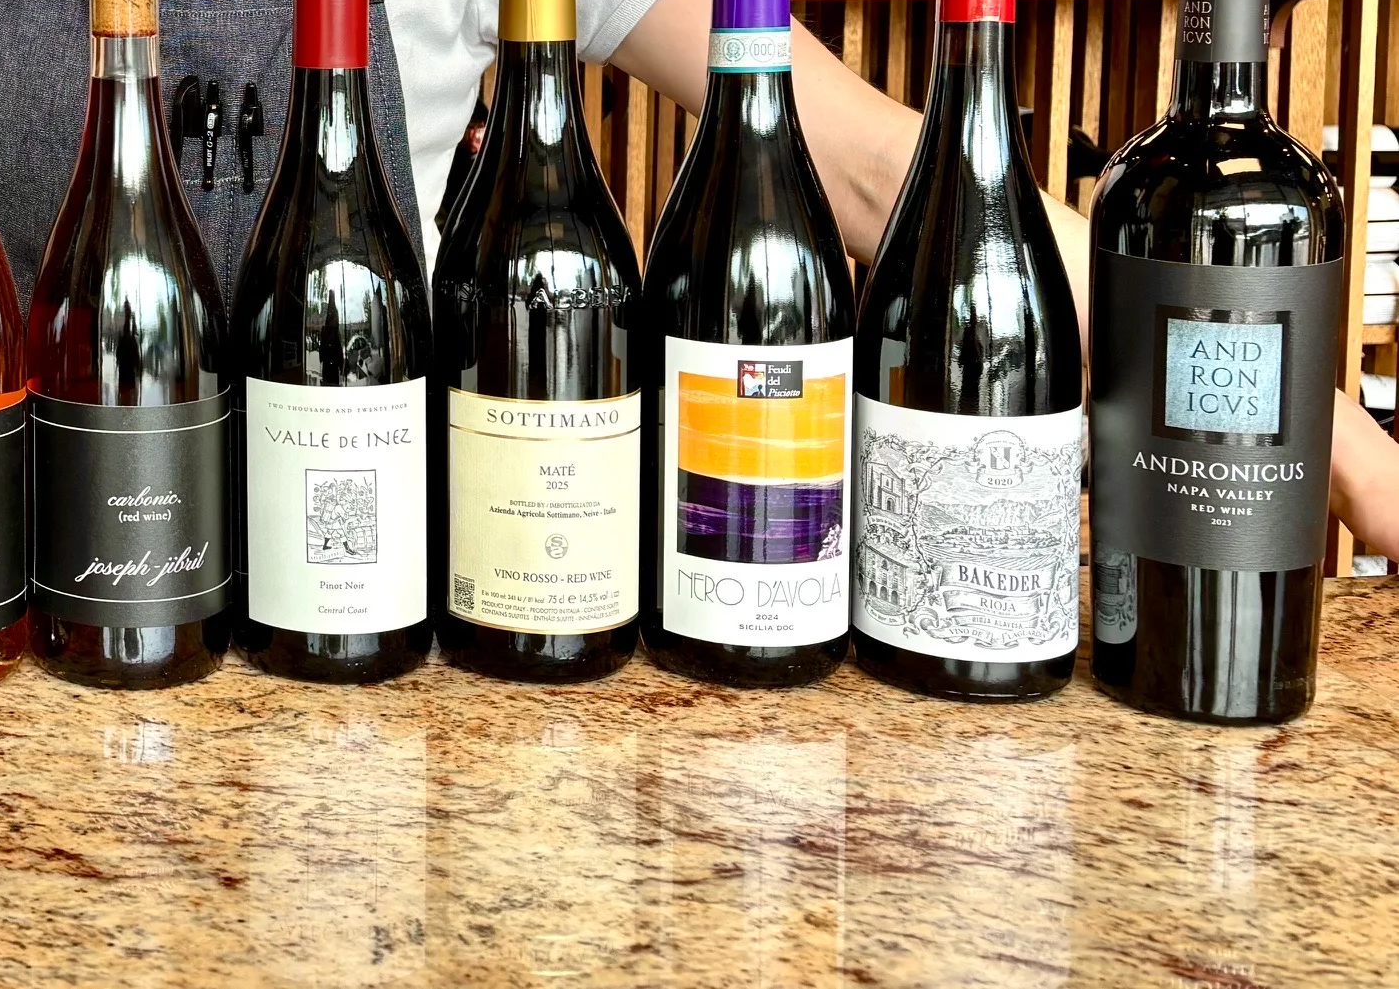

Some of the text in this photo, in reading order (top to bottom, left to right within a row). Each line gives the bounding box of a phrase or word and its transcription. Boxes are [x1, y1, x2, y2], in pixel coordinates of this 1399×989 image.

[1184, 1, 1212, 13] AND
[1184, 16, 1211, 29] RON
[1182, 30, 1212, 45] ICVS
[1190, 338, 1262, 362] AND
[767, 365, 792, 374] Feudi
[767, 377, 781, 386] del
[1191, 365, 1259, 389] RON
[768, 388, 801, 398] Pisciotto
[287, 405, 330, 413] THOUSAND
[1186, 391, 1260, 416] ICVS
[486, 409, 619, 428] SOTTIMANO
[265, 426, 412, 449] VALLE DE INEZ
[539, 464, 576, 477] MATÉ
[1132, 451, 1305, 482] ANDRONICUS
[987, 477, 1013, 486] 2020
[107, 486, 182, 507] carbonic.
[1167, 482, 1274, 501] NAPA VALLEY
[118, 509, 172, 523] (red wine)
[489, 505, 515, 515] Azienda
[517, 509, 545, 519] Agricola
[1191, 503, 1253, 516] RED WINE
[1211, 517, 1232, 526] 2023
[494, 568, 612, 583] VINO ROSSO RED WINE
[959, 565, 1041, 592] BAKEDER
[319, 581, 365, 590] Pinot Noir
[678, 568, 842, 608] NERO D'AVOLA
[548, 595, 557, 603] 75
[980, 597, 1016, 612] RIOJA
[318, 605, 367, 614] Central Coast
[755, 613, 779, 621] 2024
[739, 623, 773, 632] SICILIA
